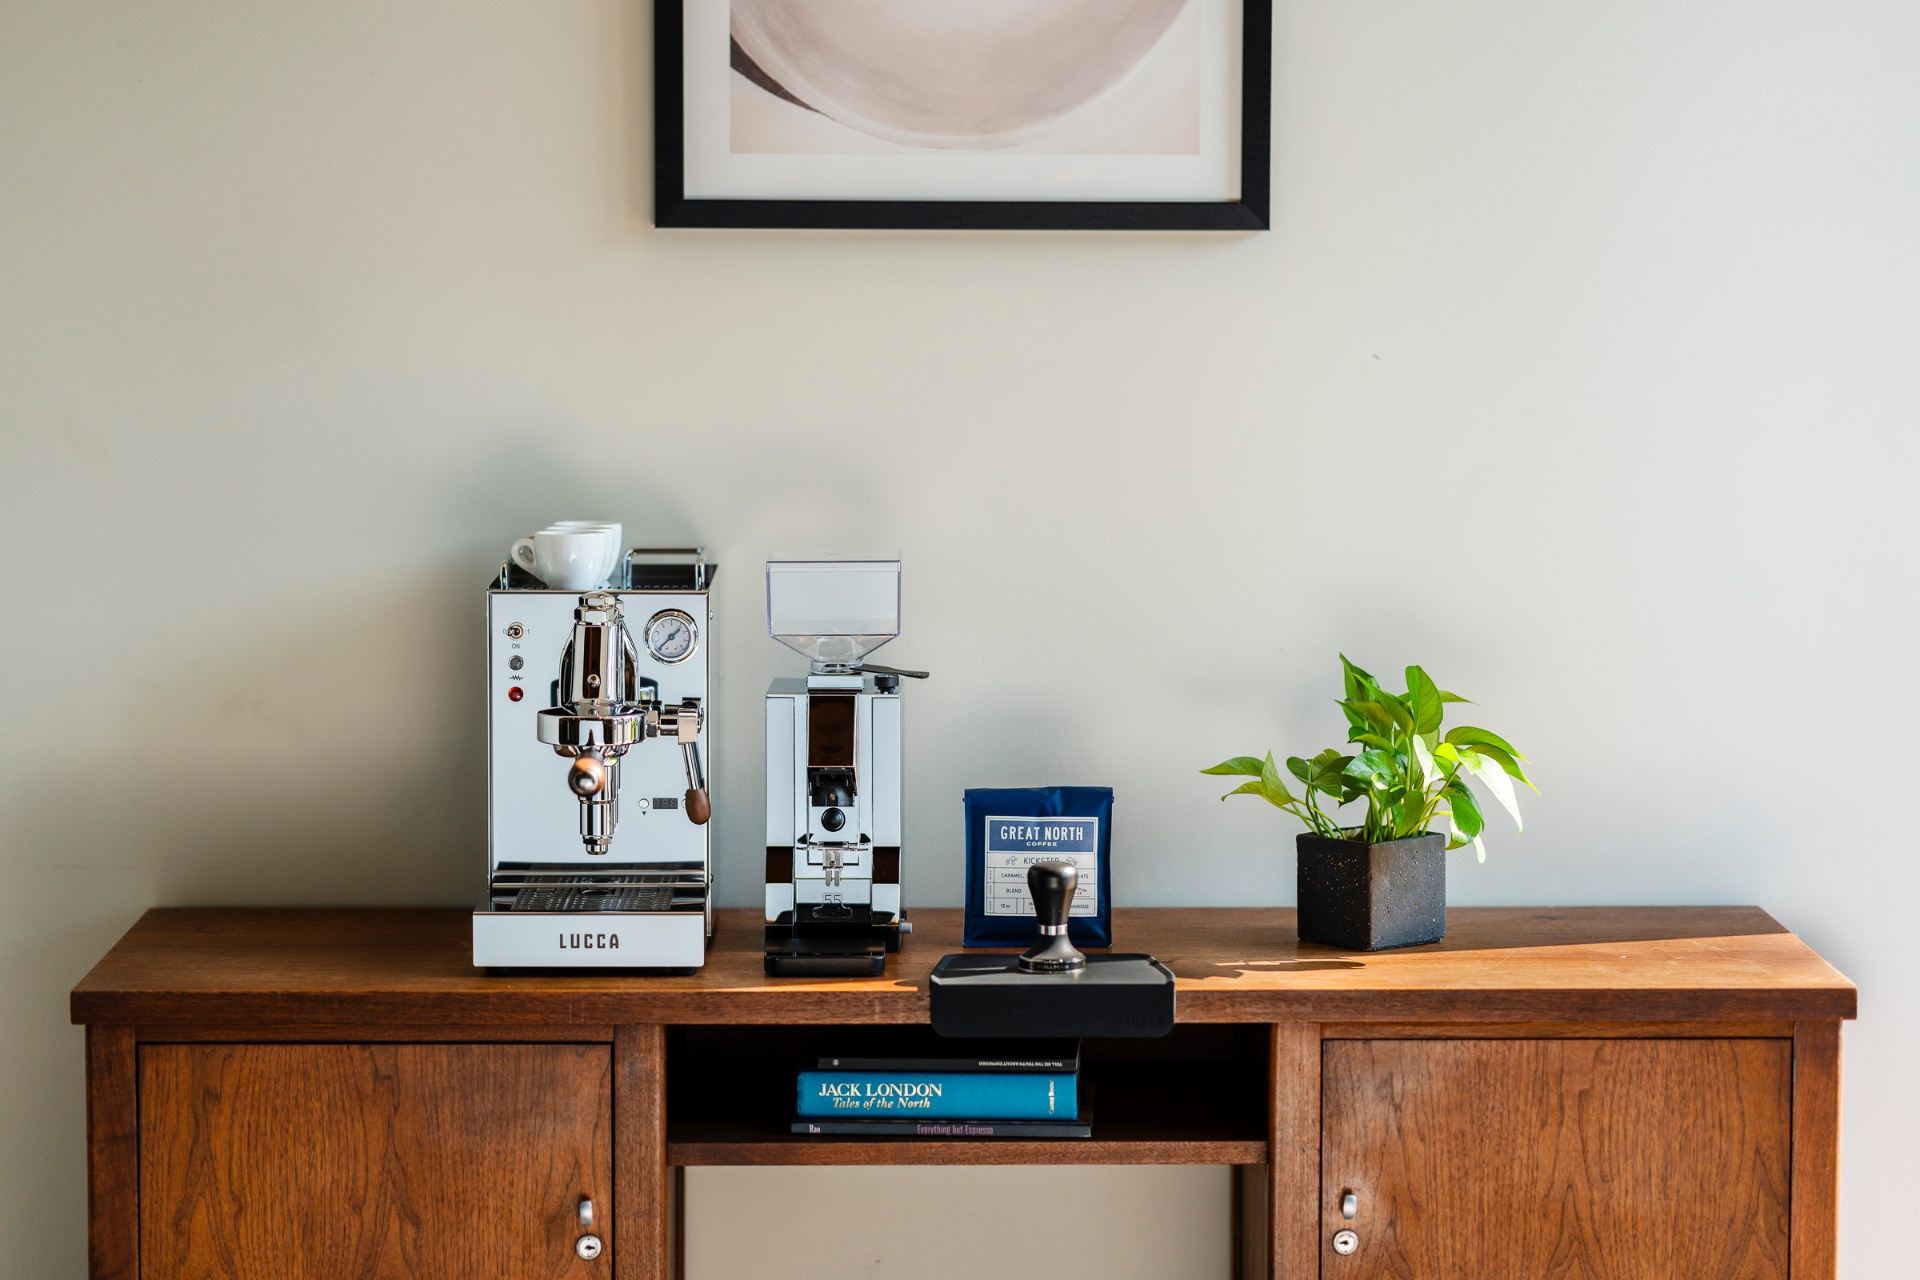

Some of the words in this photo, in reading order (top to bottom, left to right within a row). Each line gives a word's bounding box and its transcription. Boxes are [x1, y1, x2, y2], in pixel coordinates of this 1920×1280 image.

[1000, 826, 1040, 840] GREAT
[1044, 826, 1083, 841] NORTH
[559, 933, 619, 949] LUCCA
[818, 1083, 862, 1097] JACK
[865, 1083, 943, 1097] LONDON
[833, 1097, 860, 1109] Tales
[863, 1097, 876, 1110] of
[876, 1097, 894, 1109] the
[897, 1097, 931, 1109] North
[809, 1124, 821, 1134] Rao
[917, 1123, 951, 1135] Everything
[952, 1123, 963, 1134] but
[965, 1123, 994, 1135] Espresso
